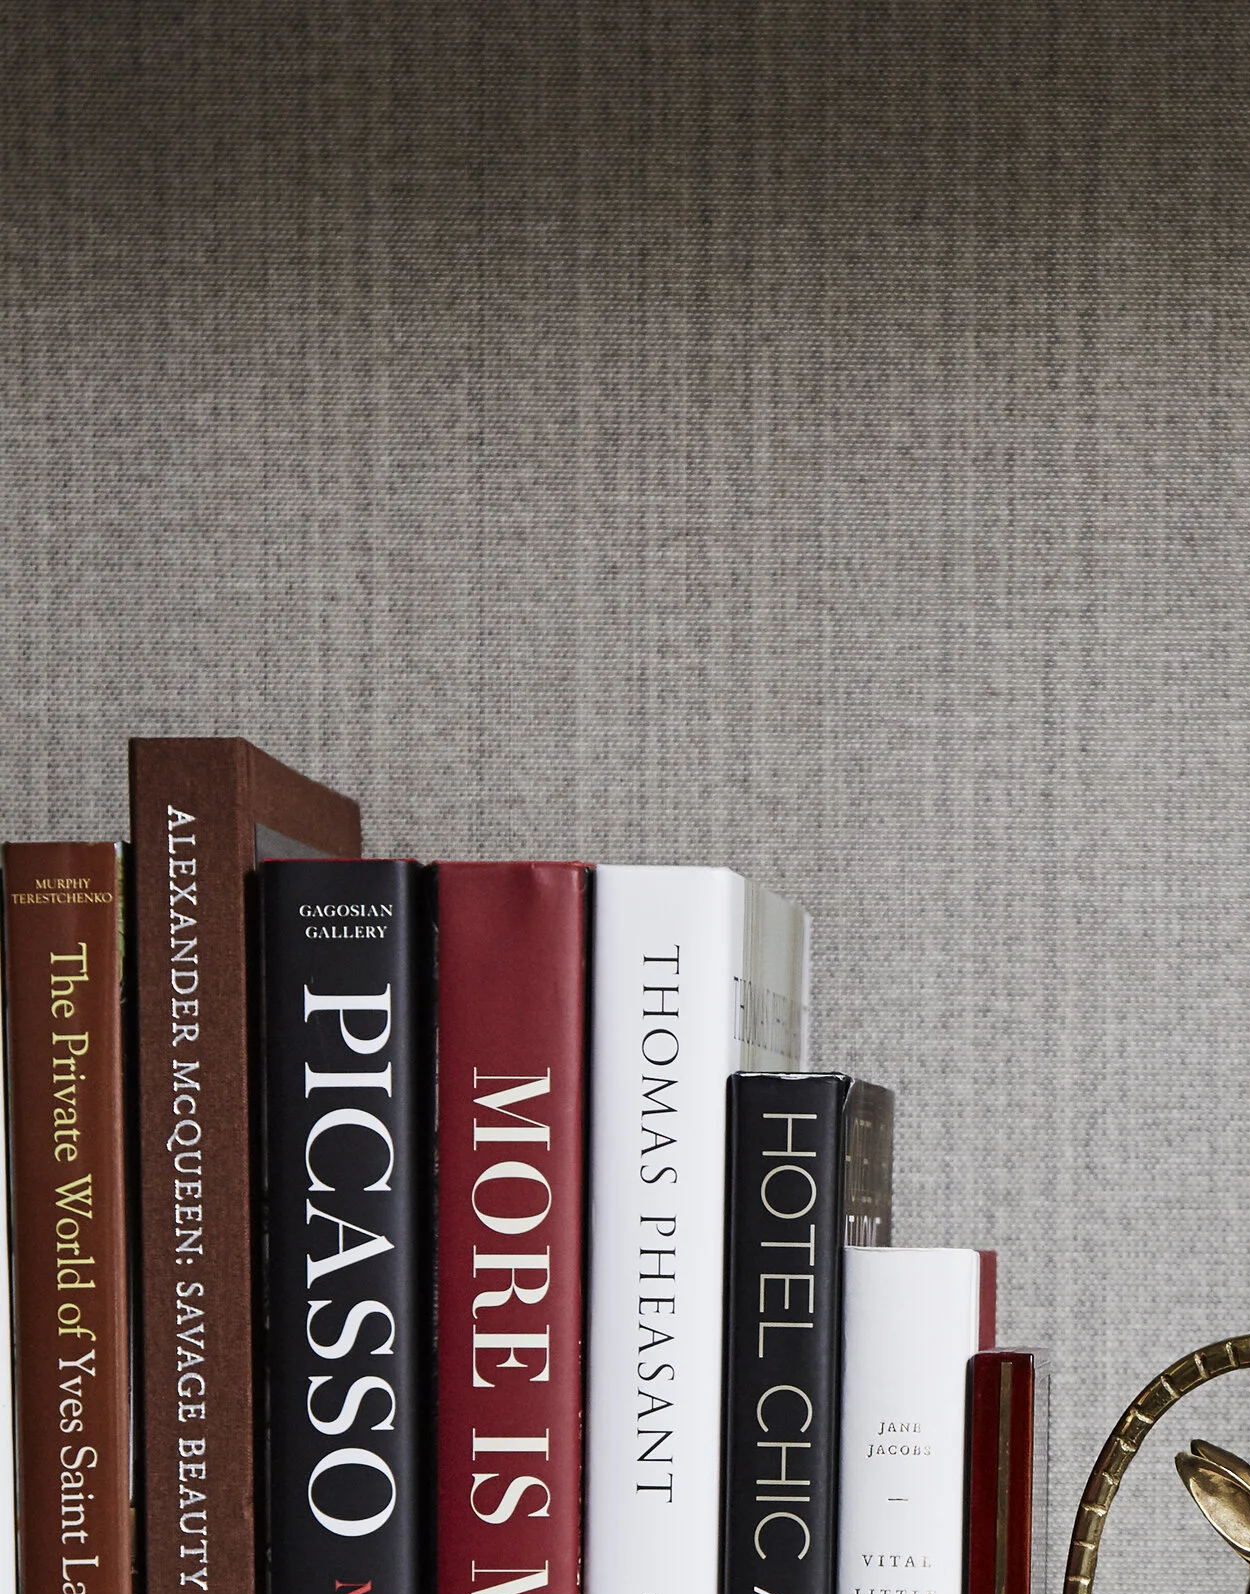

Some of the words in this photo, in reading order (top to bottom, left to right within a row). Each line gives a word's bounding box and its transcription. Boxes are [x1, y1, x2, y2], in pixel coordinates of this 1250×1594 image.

[12, 892, 113, 904] TERESTCHENKO
[36, 878, 90, 889] MURPHY
[168, 805, 199, 1046] ALEXANDER
[300, 905, 392, 917] GAGOSIAN
[306, 926, 387, 938] GALLERY
[51, 942, 89, 1018] The
[53, 1032, 88, 1161] Private
[640, 945, 679, 1183] THOMAS
[55, 1174, 95, 1290] World
[304, 983, 396, 1536] PICASSO
[472, 1067, 552, 1387] MORE
[759, 1114, 817, 1358] HOTEL
[58, 1303, 96, 1341] of
[176, 1282, 205, 1422] SAVAGE
[637, 1216, 676, 1502] PHEASANT
[59, 1349, 95, 1432] Yves
[878, 1422, 921, 1435] JANE
[60, 1446, 97, 1544] Saint
[471, 1428, 550, 1524] IS
[755, 1385, 812, 1560] CHIC
[868, 1445, 931, 1457] JACOBS
[179, 1438, 208, 1590] BEAUTY
[862, 1555, 931, 1567] VITAL
